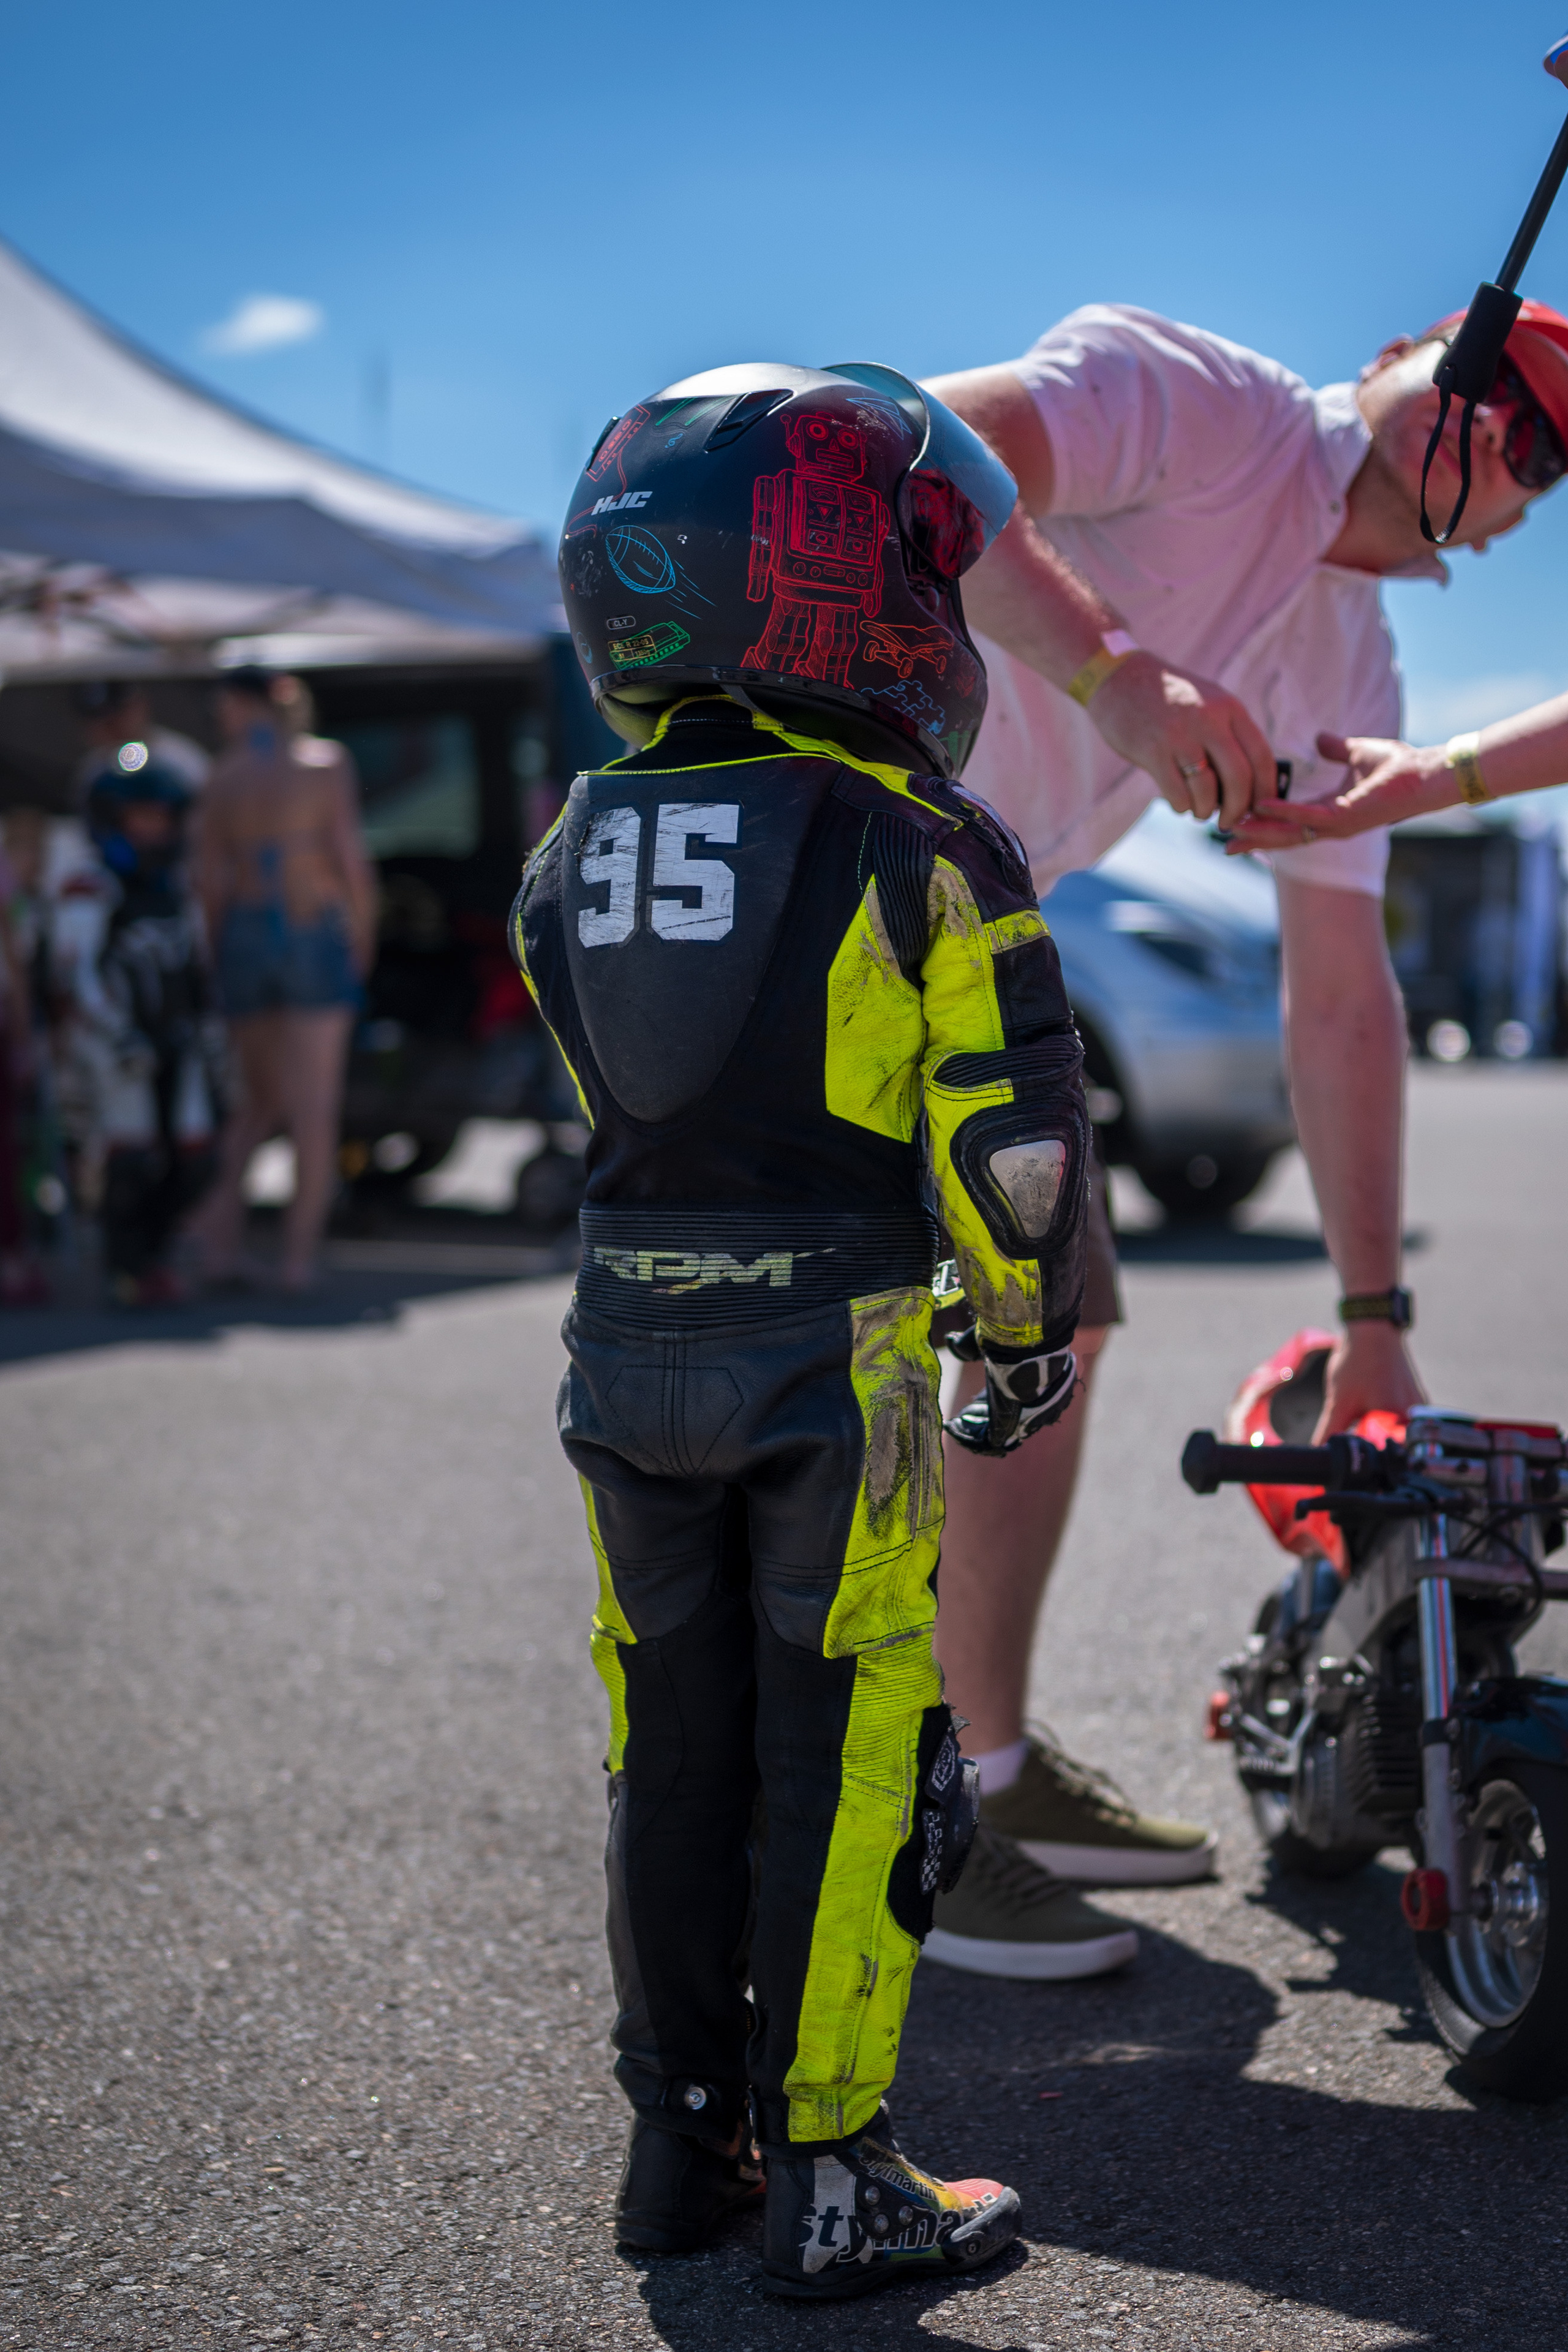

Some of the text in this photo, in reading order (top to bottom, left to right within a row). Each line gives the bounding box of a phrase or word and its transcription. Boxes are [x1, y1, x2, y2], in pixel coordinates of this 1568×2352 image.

[590, 491, 653, 516] HJC
[578, 802, 740, 949] 95
[593, 1246, 794, 1295] RPM
